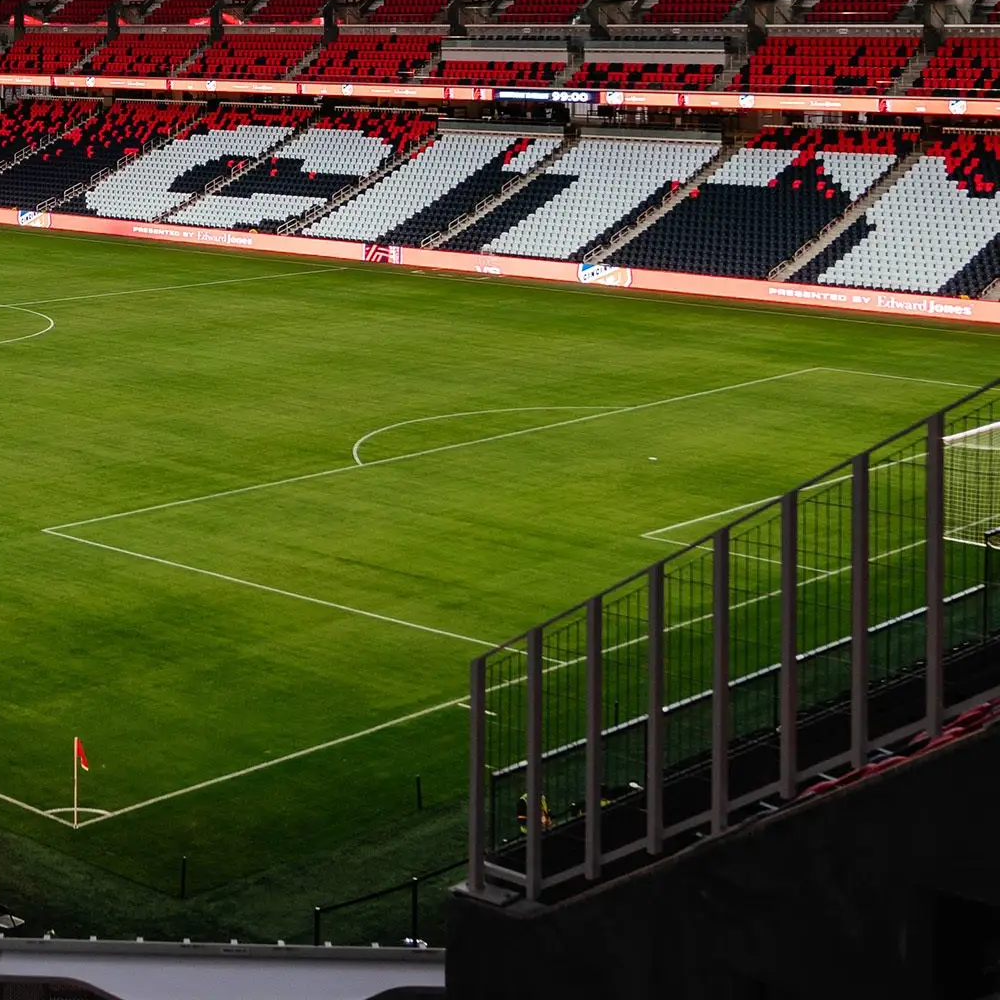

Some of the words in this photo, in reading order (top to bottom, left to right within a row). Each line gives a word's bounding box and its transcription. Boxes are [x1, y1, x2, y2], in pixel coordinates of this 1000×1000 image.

[552, 91, 589, 102] 99:00
[133, 226, 180, 237] PRESENTED
[197, 231, 227, 243] Edward
[227, 233, 253, 246] Jones
[768, 287, 848, 303] PRESENTED
[852, 296, 871, 304] BY
[876, 294, 929, 313] Edward
[929, 299, 973, 316] Jones
